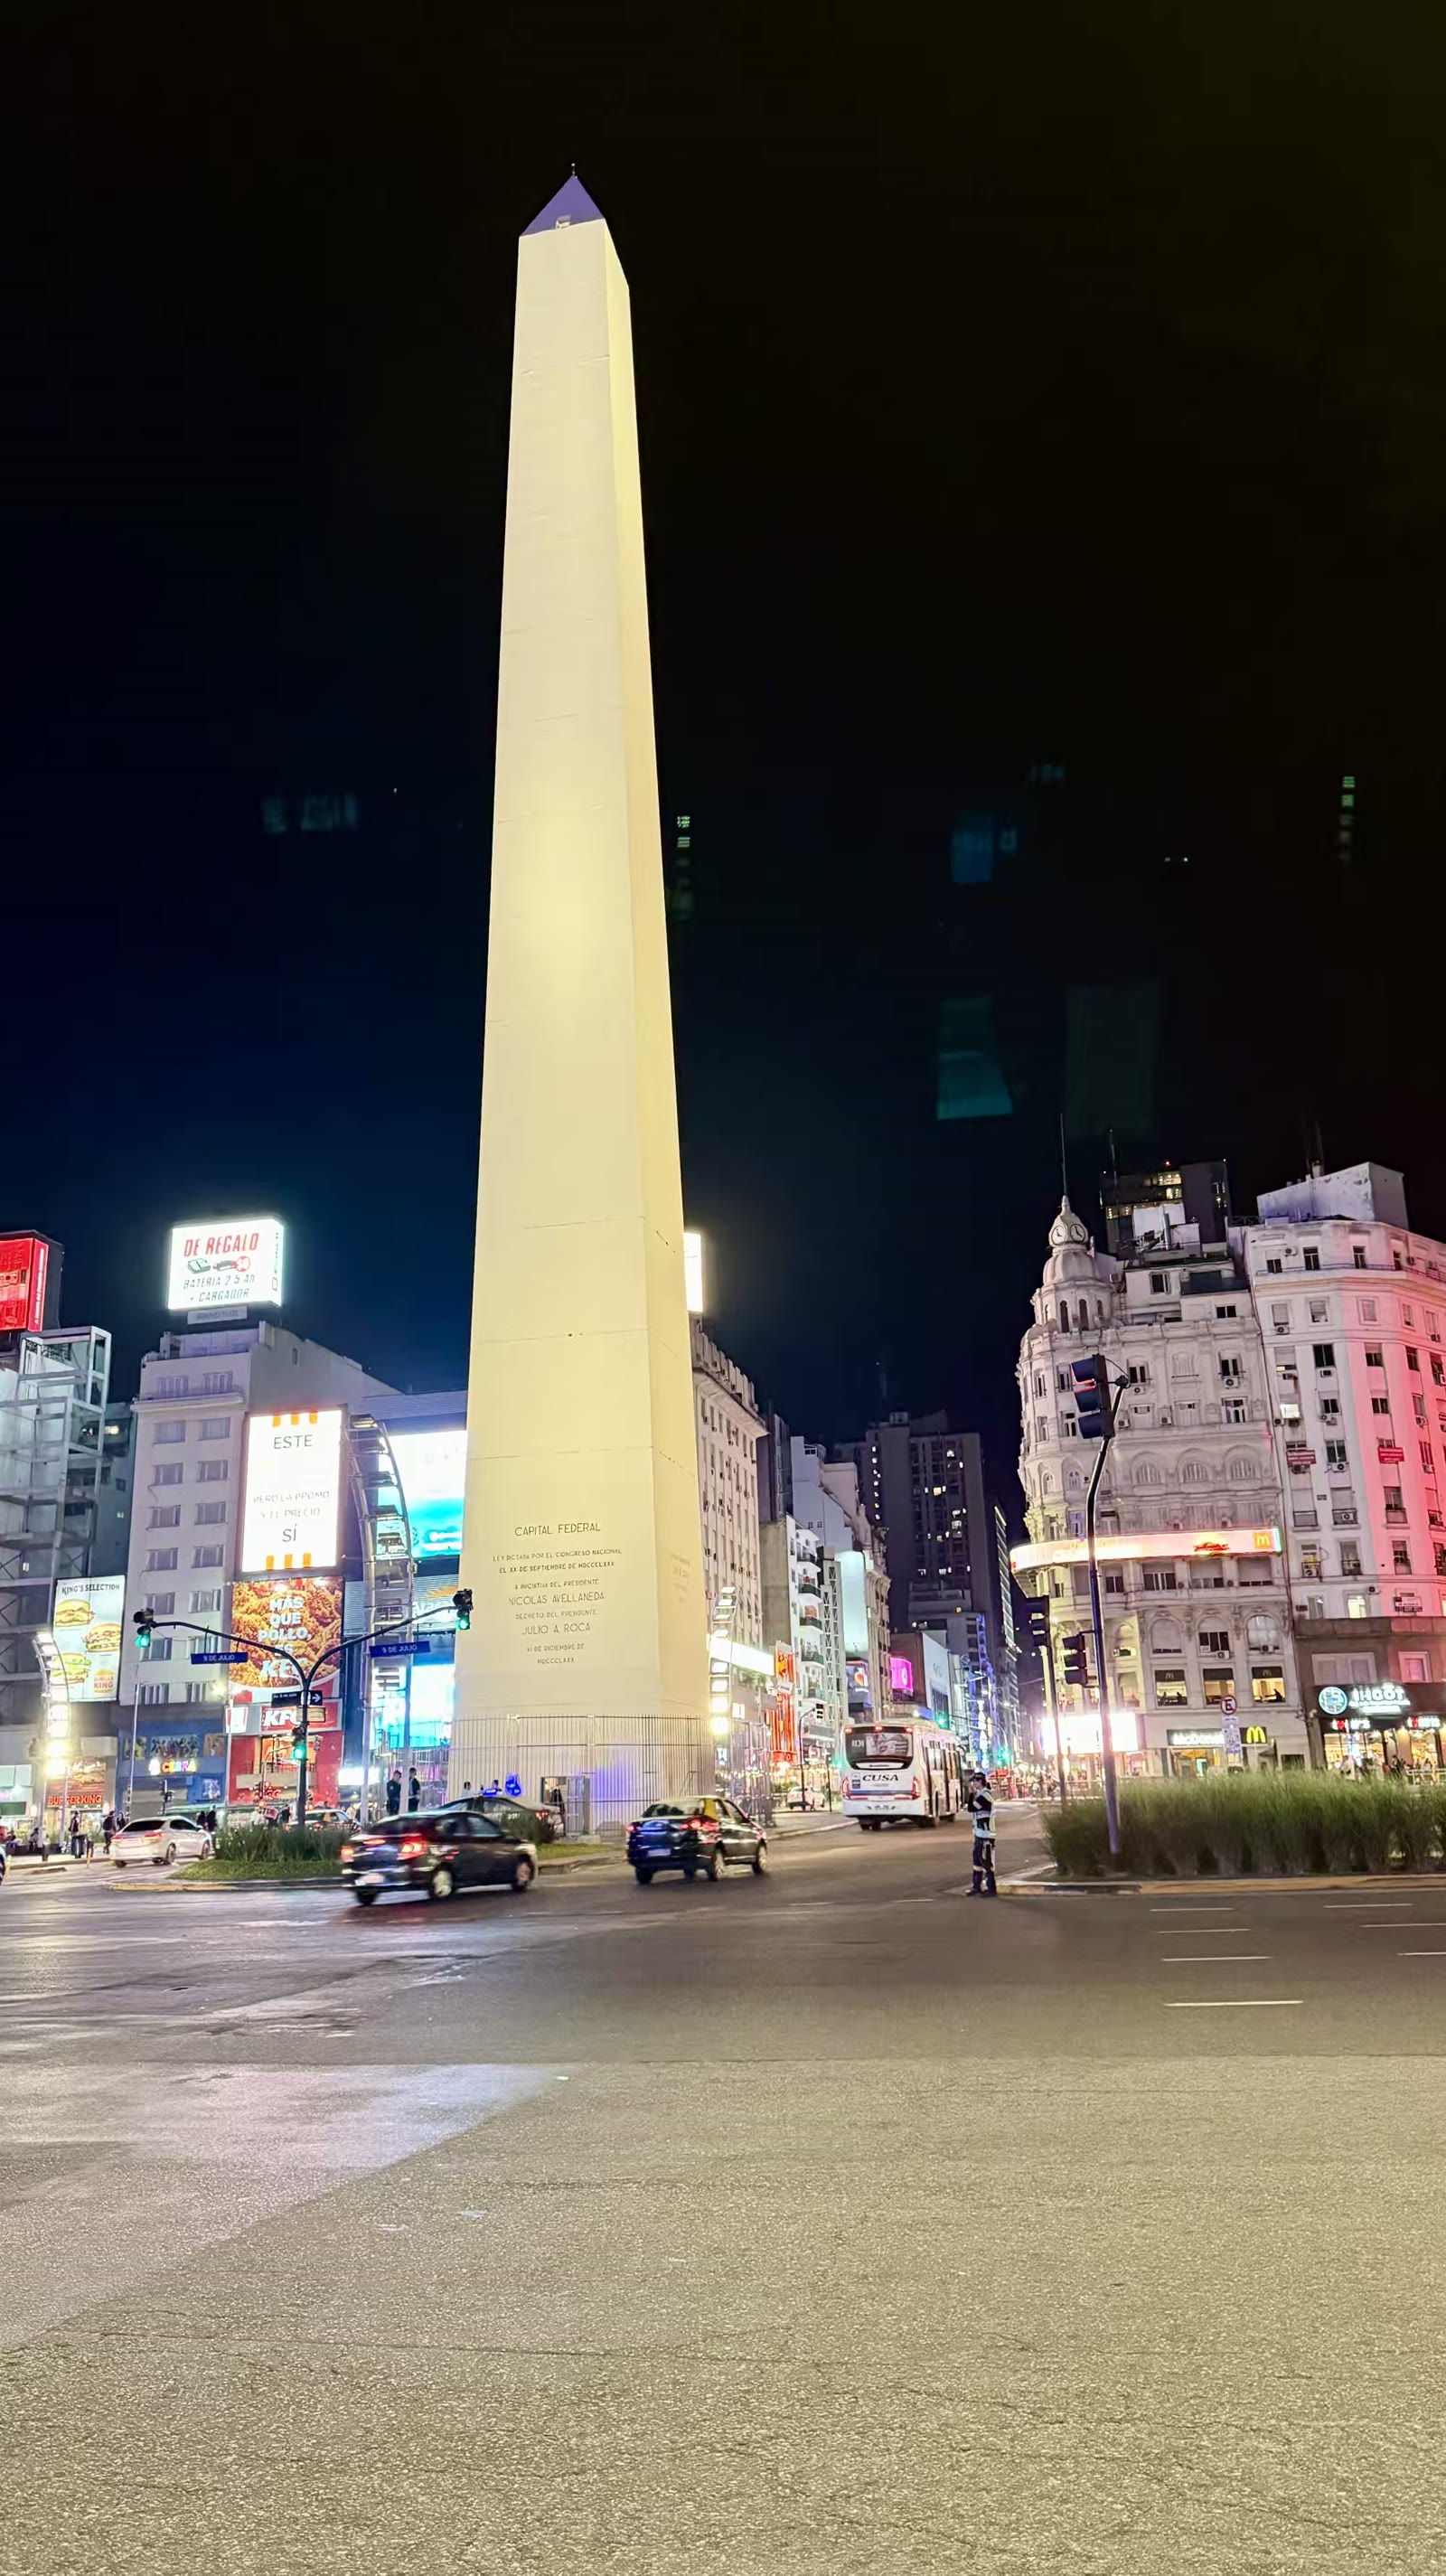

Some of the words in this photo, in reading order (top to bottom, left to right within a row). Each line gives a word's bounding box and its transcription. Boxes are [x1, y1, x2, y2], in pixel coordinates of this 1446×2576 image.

[183, 1238, 201, 1257] DE
[205, 1233, 259, 1255] REGALO
[183, 1276, 221, 1290] BATERIA
[273, 1434, 314, 1450] ESTE
[282, 1523, 298, 1543] SÍ
[514, 1525, 553, 1537] CAPITAL
[558, 1522, 601, 1534] FEDERAL
[556, 1549, 590, 1558] CONGRESO
[530, 1563, 567, 1572] SEPTIEMBRE
[61, 1584, 84, 1595] KING'S
[85, 1583, 120, 1592] SELECTION
[521, 1582, 549, 1590] INICIATIVA
[563, 1578, 599, 1587] PRESIDENTE
[269, 1595, 304, 1610] MÁS
[508, 1594, 548, 1606] NICOLAS
[552, 1591, 605, 1603] AVELLANEDA
[269, 1612, 302, 1627] QUE
[515, 1612, 544, 1620] DECRETO
[561, 1609, 596, 1617] PRESIDENTE
[258, 1627, 312, 1642] POLLO,
[521, 1624, 549, 1635] JULIO
[563, 1622, 591, 1632] ROCA
[399, 1644, 418, 1652] JULIO
[543, 1643, 575, 1651] DICIEMBRE
[94, 1680, 114, 1689] KING
[81, 1794, 102, 1804] KING
